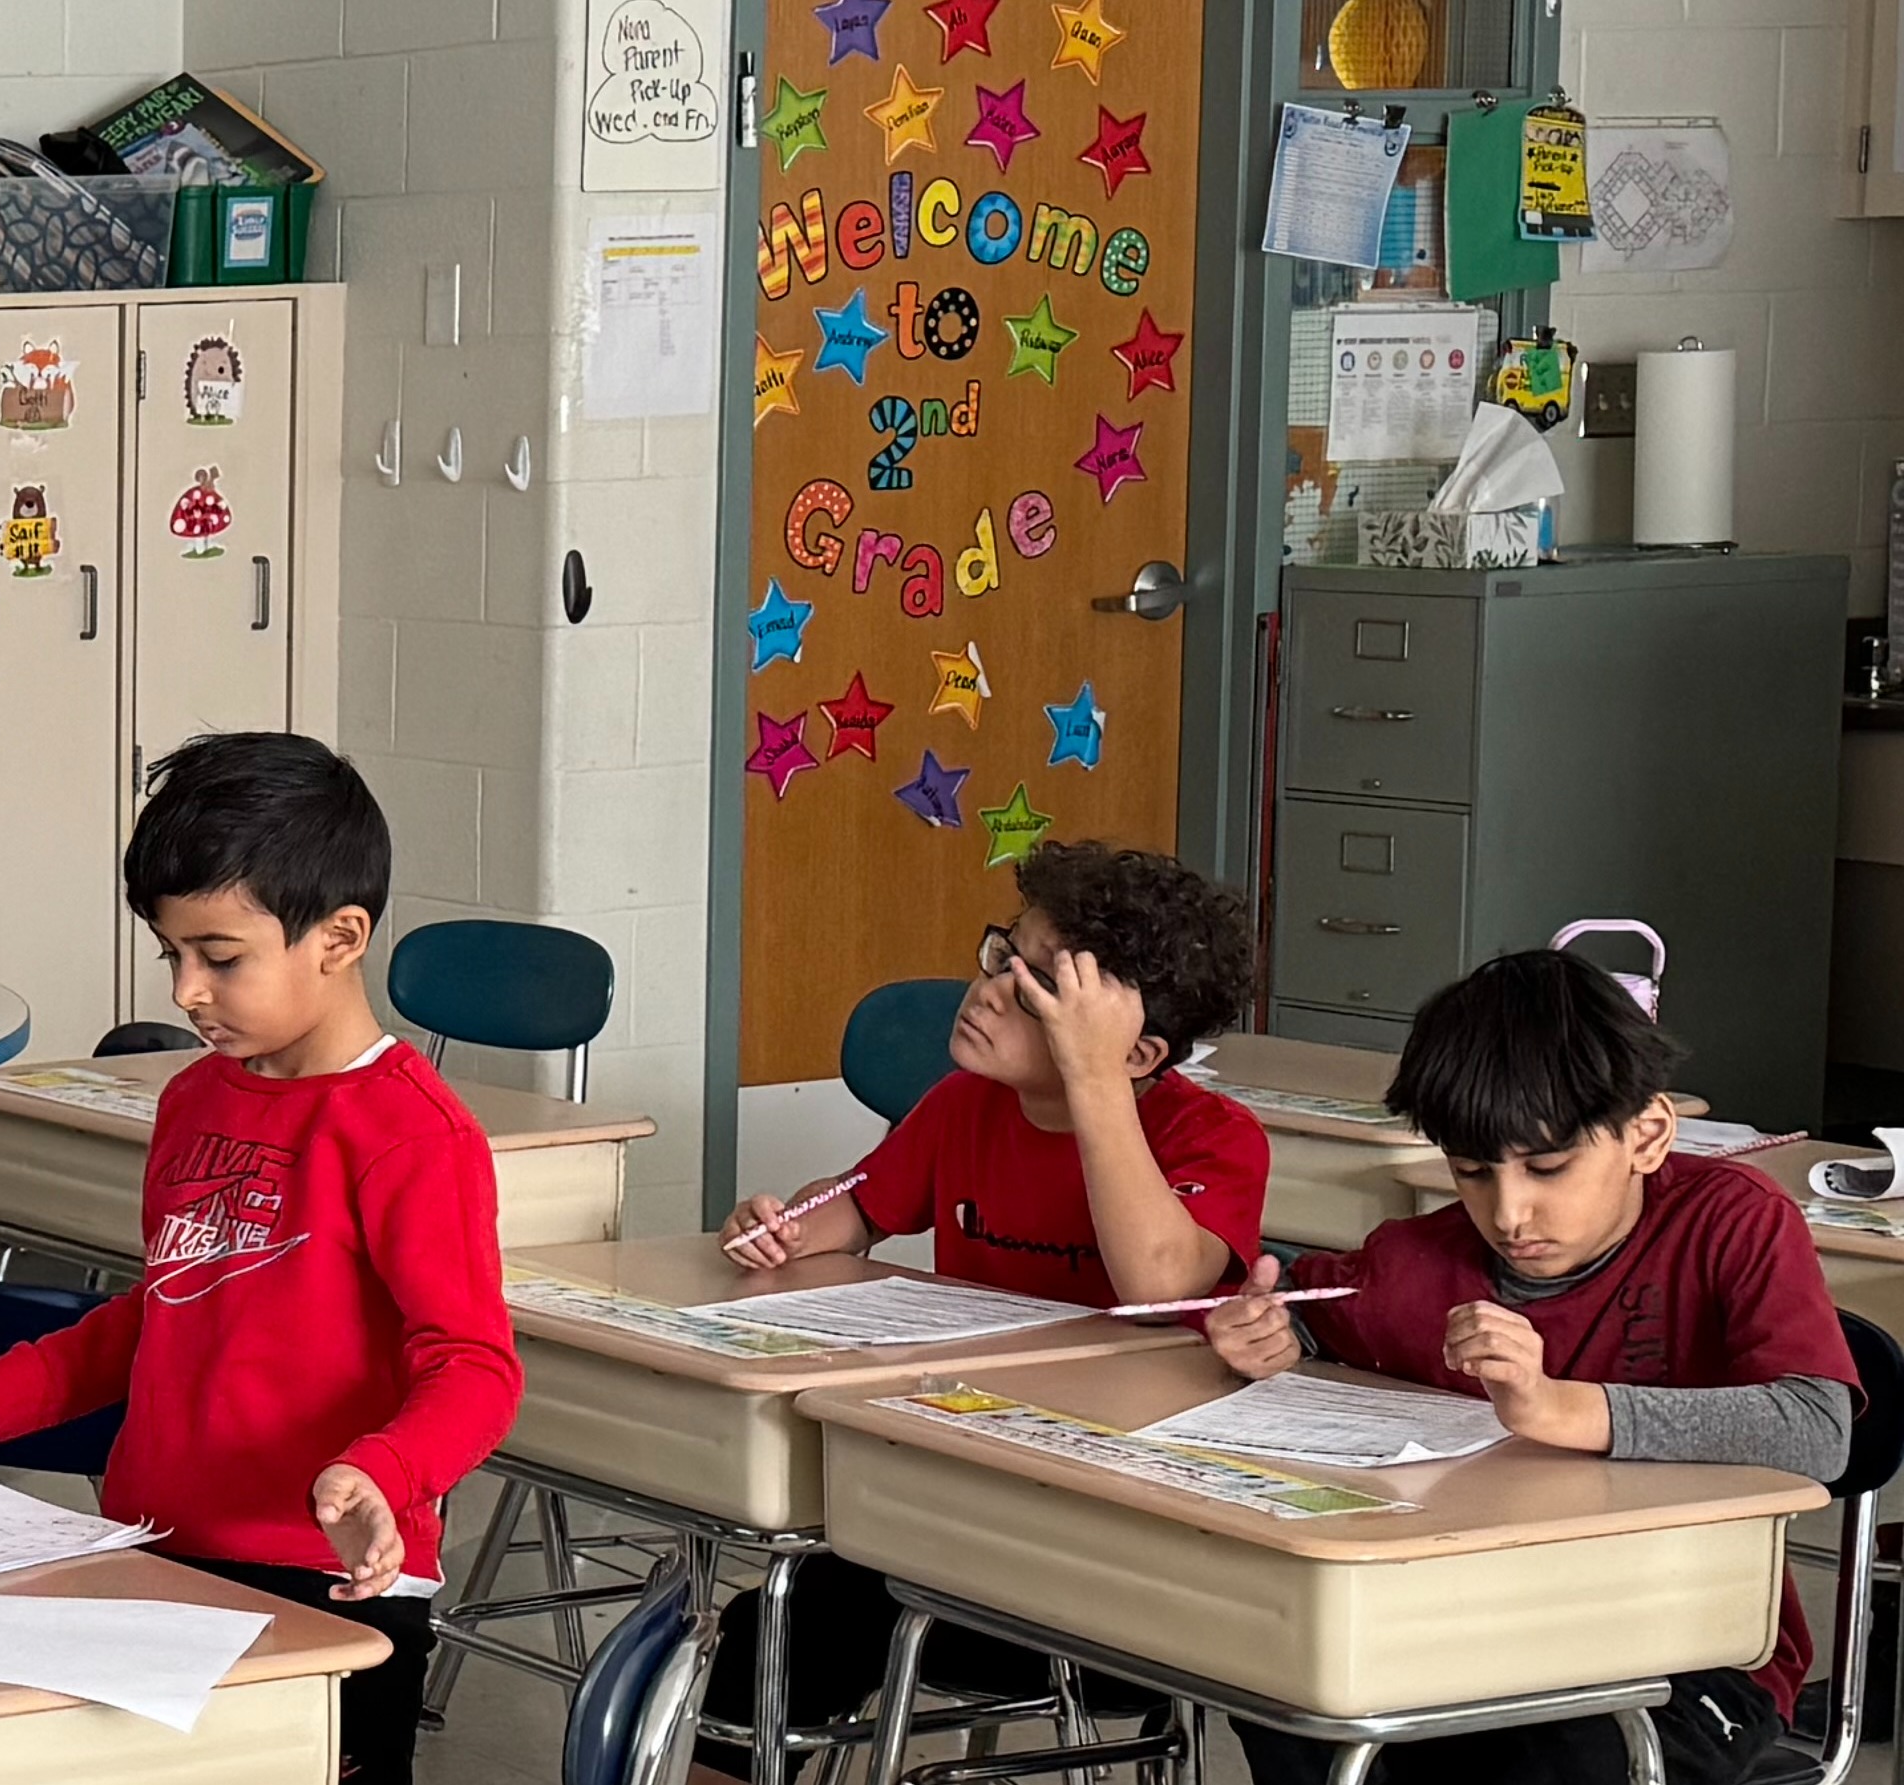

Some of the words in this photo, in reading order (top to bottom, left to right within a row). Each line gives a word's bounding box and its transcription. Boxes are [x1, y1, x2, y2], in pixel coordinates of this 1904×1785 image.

[623, 40, 685, 72] Parent
[136, 89, 172, 118] PAIR
[758, 170, 1150, 300] Welcome
[889, 282, 980, 361] to
[868, 380, 981, 491] 2nd
[784, 478, 1057, 618] Grade
[955, 1199, 1102, 1273] Champ
